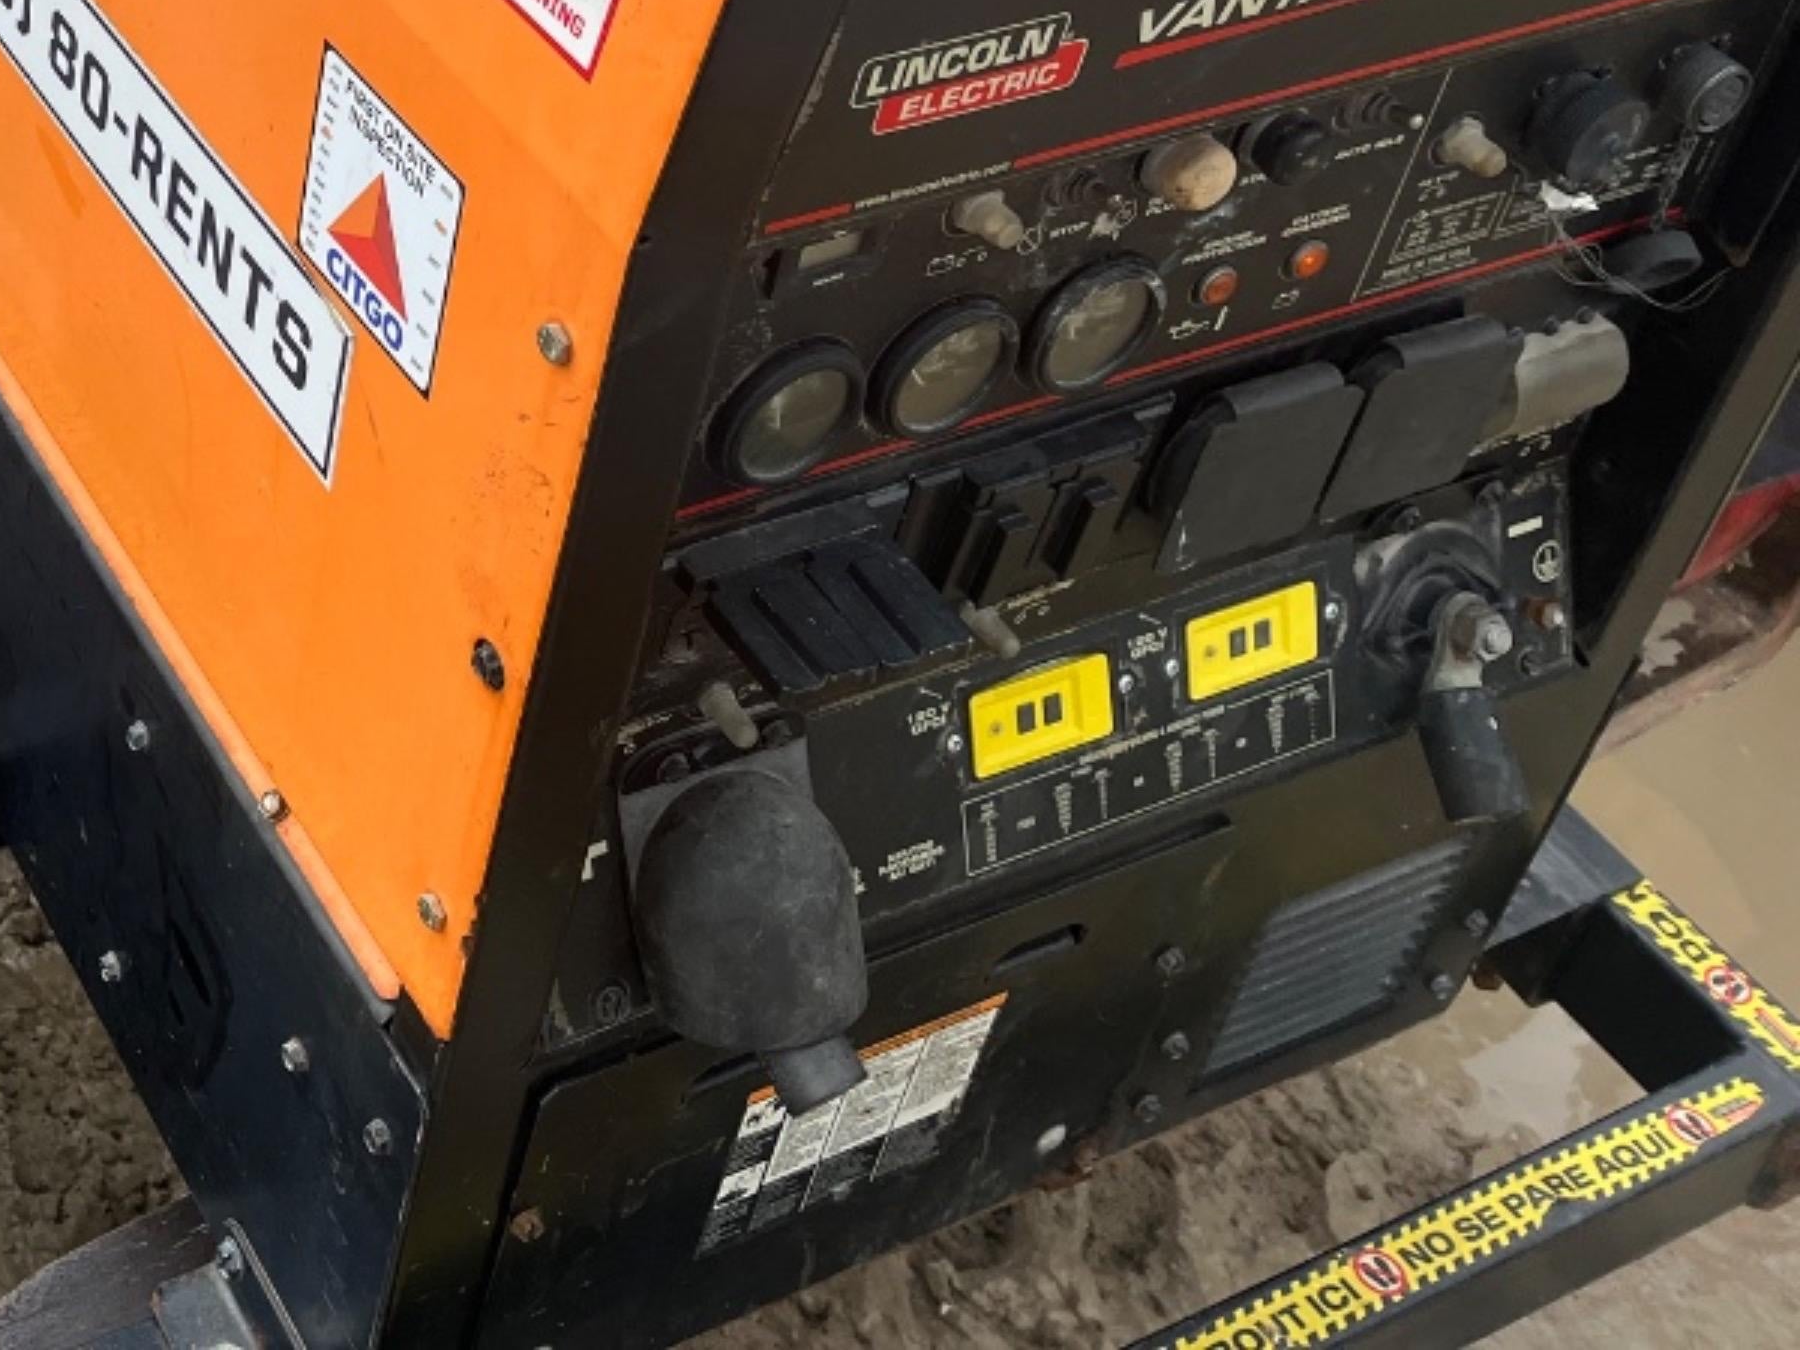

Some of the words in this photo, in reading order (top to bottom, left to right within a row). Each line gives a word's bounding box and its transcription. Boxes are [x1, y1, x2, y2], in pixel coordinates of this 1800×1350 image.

[864, 22, 1058, 99] LINCOLN
[895, 61, 1062, 122] ELECTRIC
[345, 77, 382, 126] FIRST
[383, 119, 406, 151] ON
[405, 143, 436, 185] SITE
[350, 104, 425, 198] INSPECTION
[51, 8, 312, 392] 80-RENTS
[326, 248, 404, 353] CITGO
[1304, 1276, 1363, 1318] ICI
[1401, 1223, 1457, 1271] NO
[1461, 1203, 1504, 1244] SE
[1502, 1162, 1594, 1219] PARE
